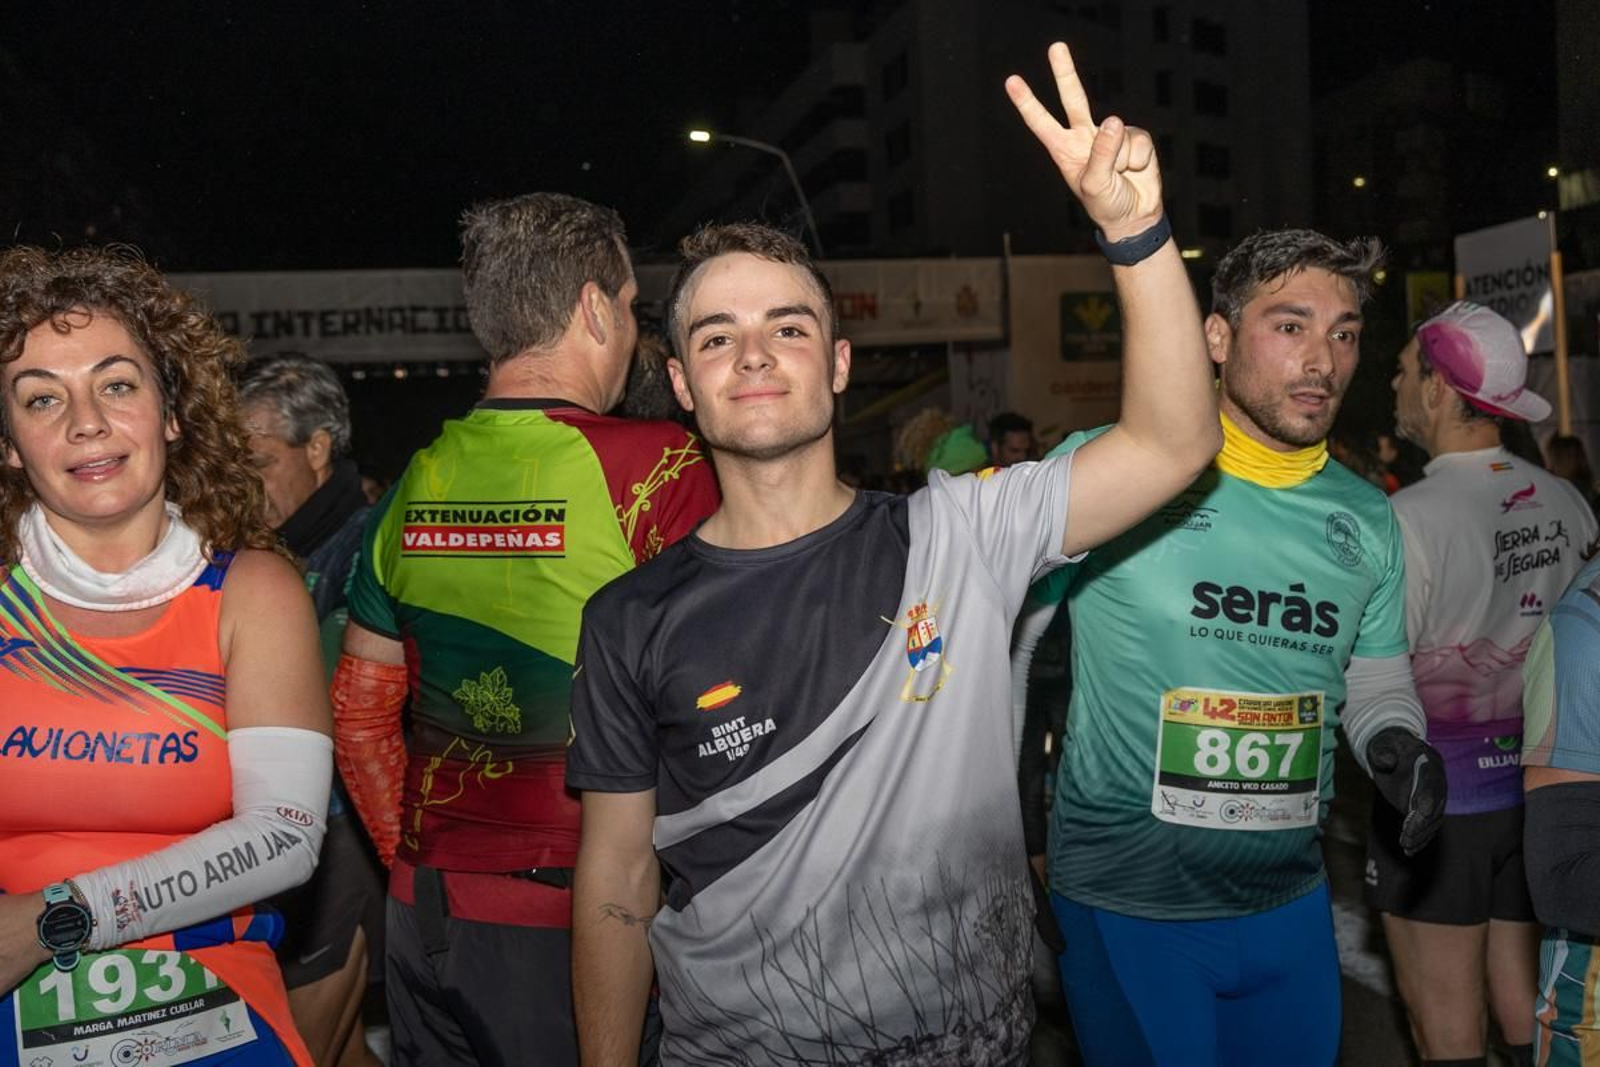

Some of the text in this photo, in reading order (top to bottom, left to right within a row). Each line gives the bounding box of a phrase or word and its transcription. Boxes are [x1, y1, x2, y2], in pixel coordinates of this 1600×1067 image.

[249, 305, 471, 339] INTERNACIO
[405, 505, 565, 524] EXTENUACIÓN
[404, 529, 561, 547] VALDEPEÑAS
[1503, 546, 1560, 583] SEGURA
[1190, 581, 1340, 638] serás
[1190, 626, 1335, 656] LO QUE QUIERAS SER
[1203, 697, 1238, 722] 42
[1237, 712, 1261, 722] SAN
[698, 718, 777, 757] ALBUERA
[711, 716, 746, 738] BIMT
[0, 725, 199, 765] AVIONETAS
[1193, 728, 1304, 779] 867
[1207, 780, 1289, 791] ANICETO VICO CASADO
[284, 807, 308, 824] KIA
[132, 870, 198, 913] AUTO
[204, 841, 260, 890] ARM
[73, 999, 205, 1036] MARGA MARTINEZ CUELLAR
